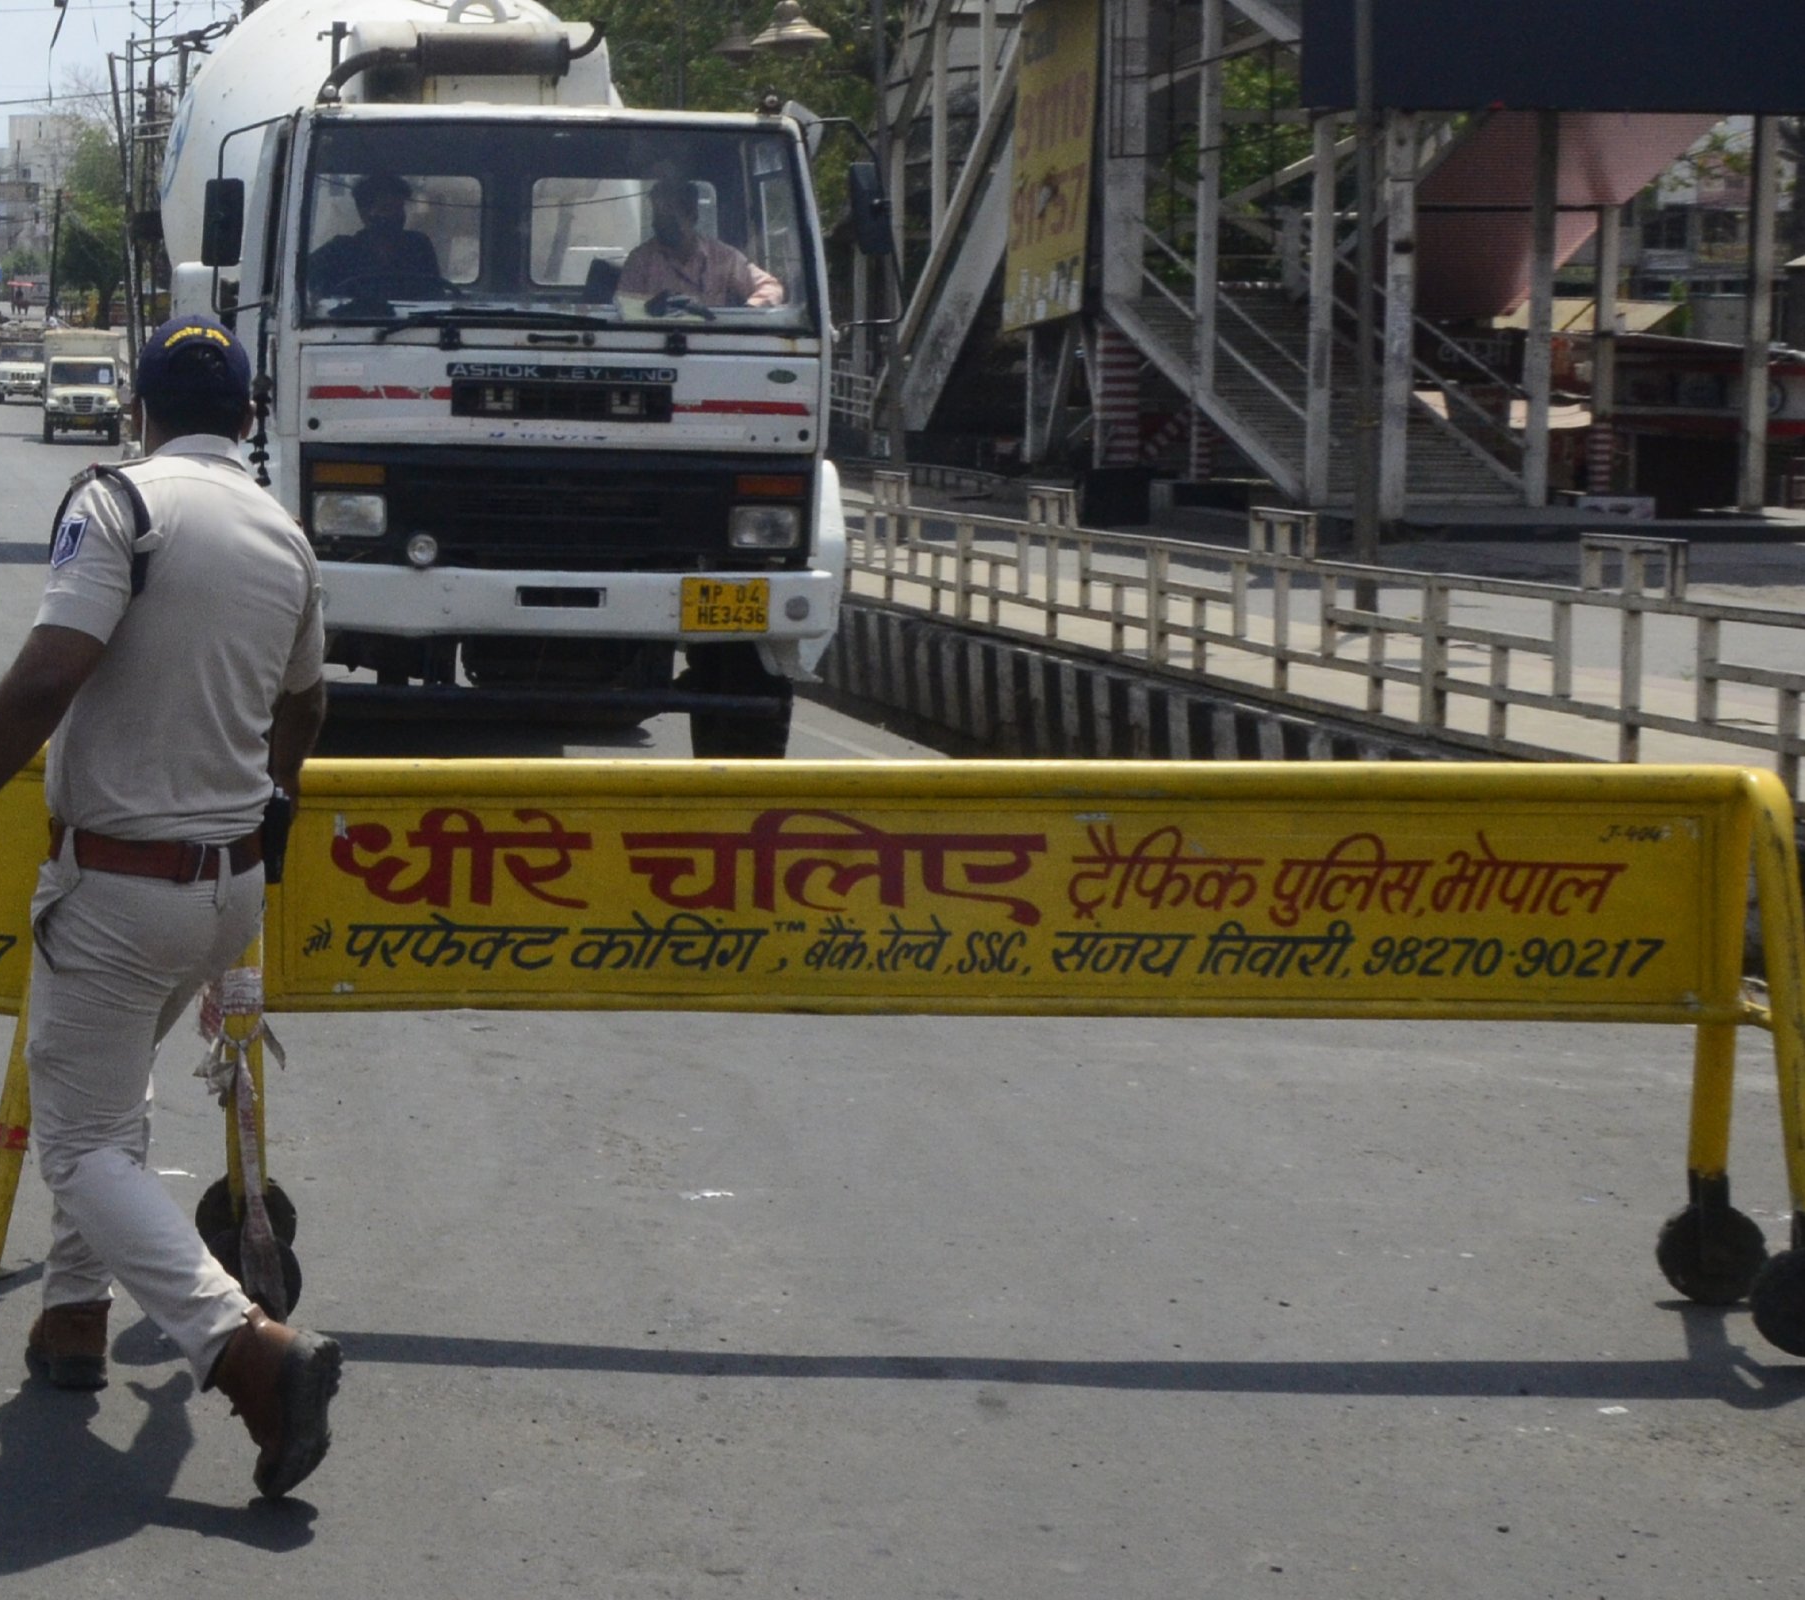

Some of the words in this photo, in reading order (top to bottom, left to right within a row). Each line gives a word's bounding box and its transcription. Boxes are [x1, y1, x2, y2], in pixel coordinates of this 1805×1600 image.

[451, 362, 540, 378] ASHOK
[700, 584, 722, 603] MP
[331, 807, 592, 909] धीरे
[622, 807, 1048, 927] चलिए
[345, 913, 568, 970] परफेक्ट
[1052, 921, 1195, 978] संजय
